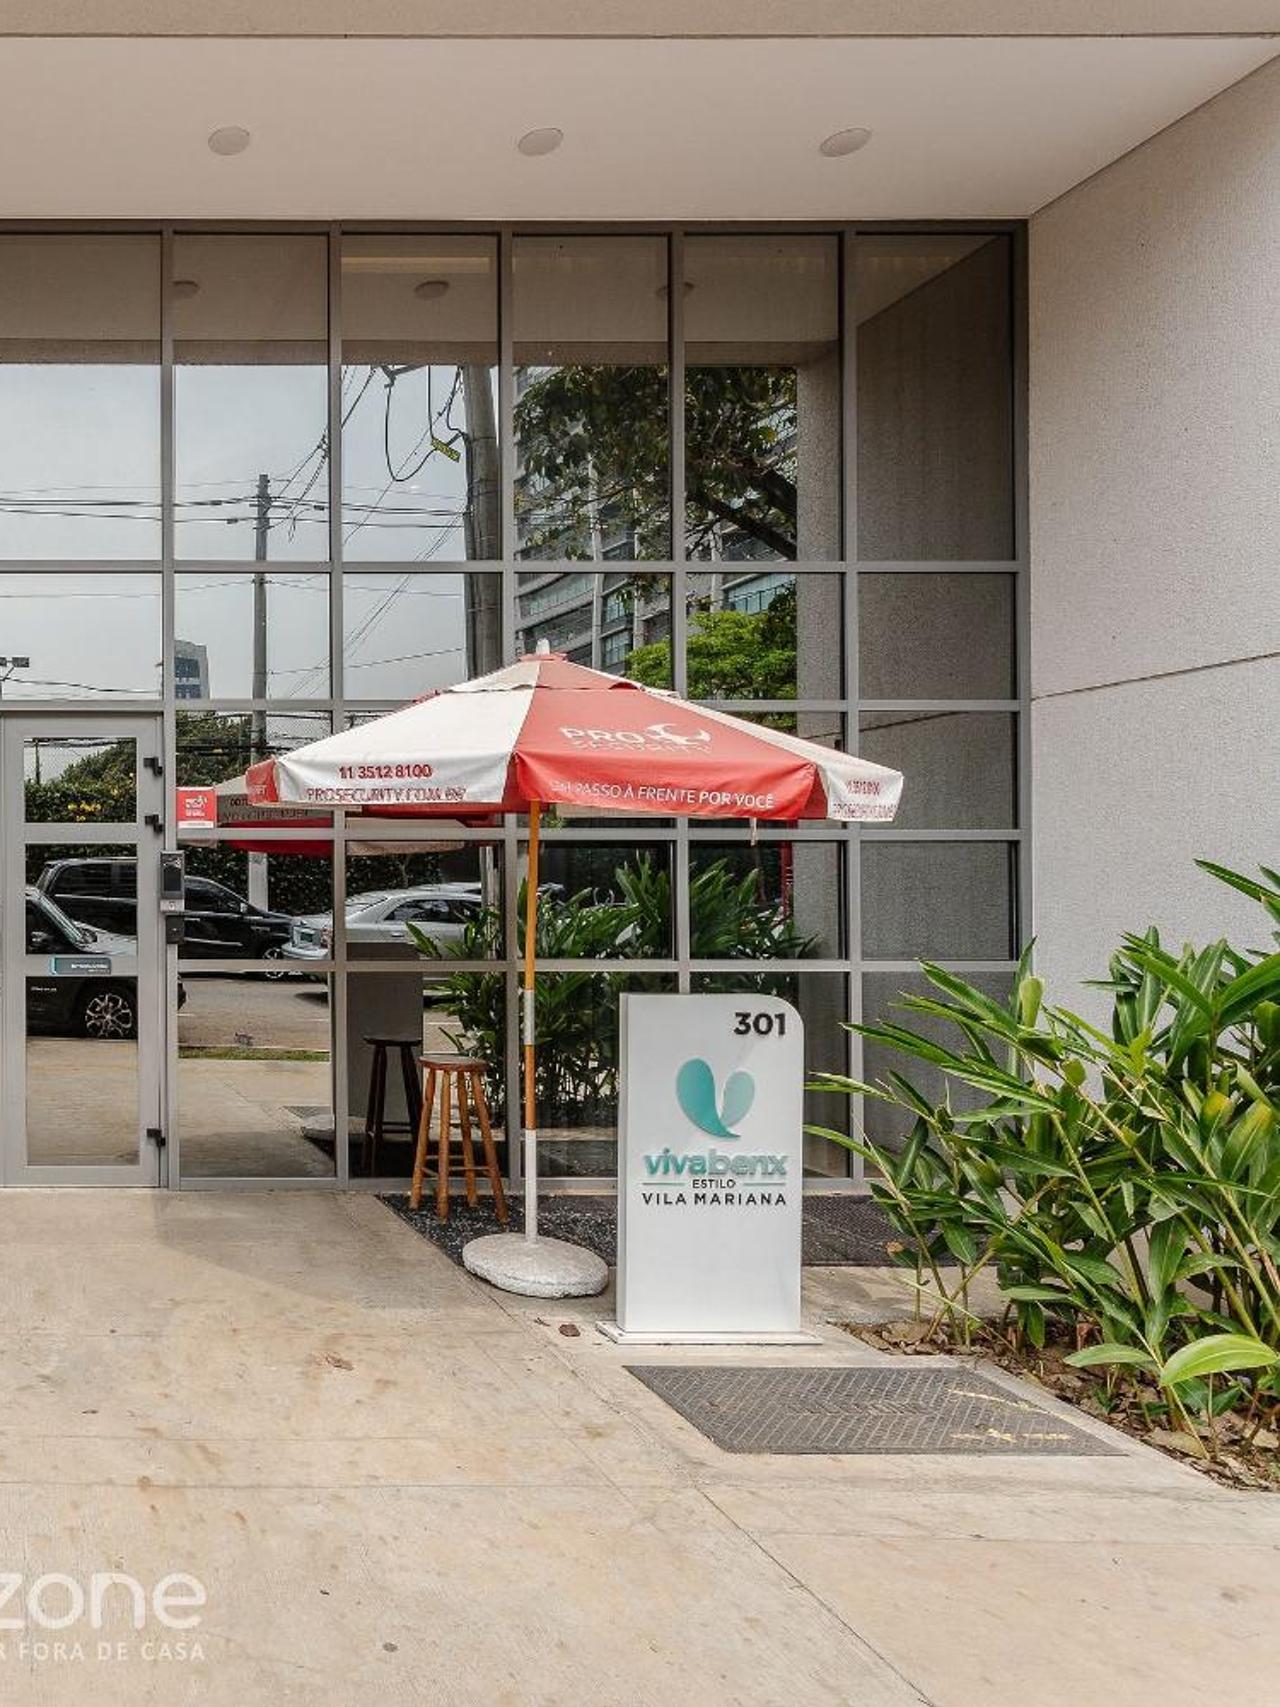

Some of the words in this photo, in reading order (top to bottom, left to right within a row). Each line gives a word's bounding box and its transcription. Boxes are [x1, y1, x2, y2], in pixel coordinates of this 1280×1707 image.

[339, 766, 354, 779] 11
[357, 766, 393, 779] 3512
[395, 764, 432, 778] 8100
[575, 781, 621, 798] PASSO
[624, 783, 634, 799] À
[637, 785, 696, 804] FRENTE
[698, 790, 732, 806] POR
[735, 792, 776, 809] VOCÊ
[732, 1012, 787, 1036] 301
[642, 1148, 788, 1176] vivabenx
[692, 1179, 736, 1190] ESTILO
[642, 1192, 687, 1206] VILA
[693, 1192, 787, 1206] MARIANA
